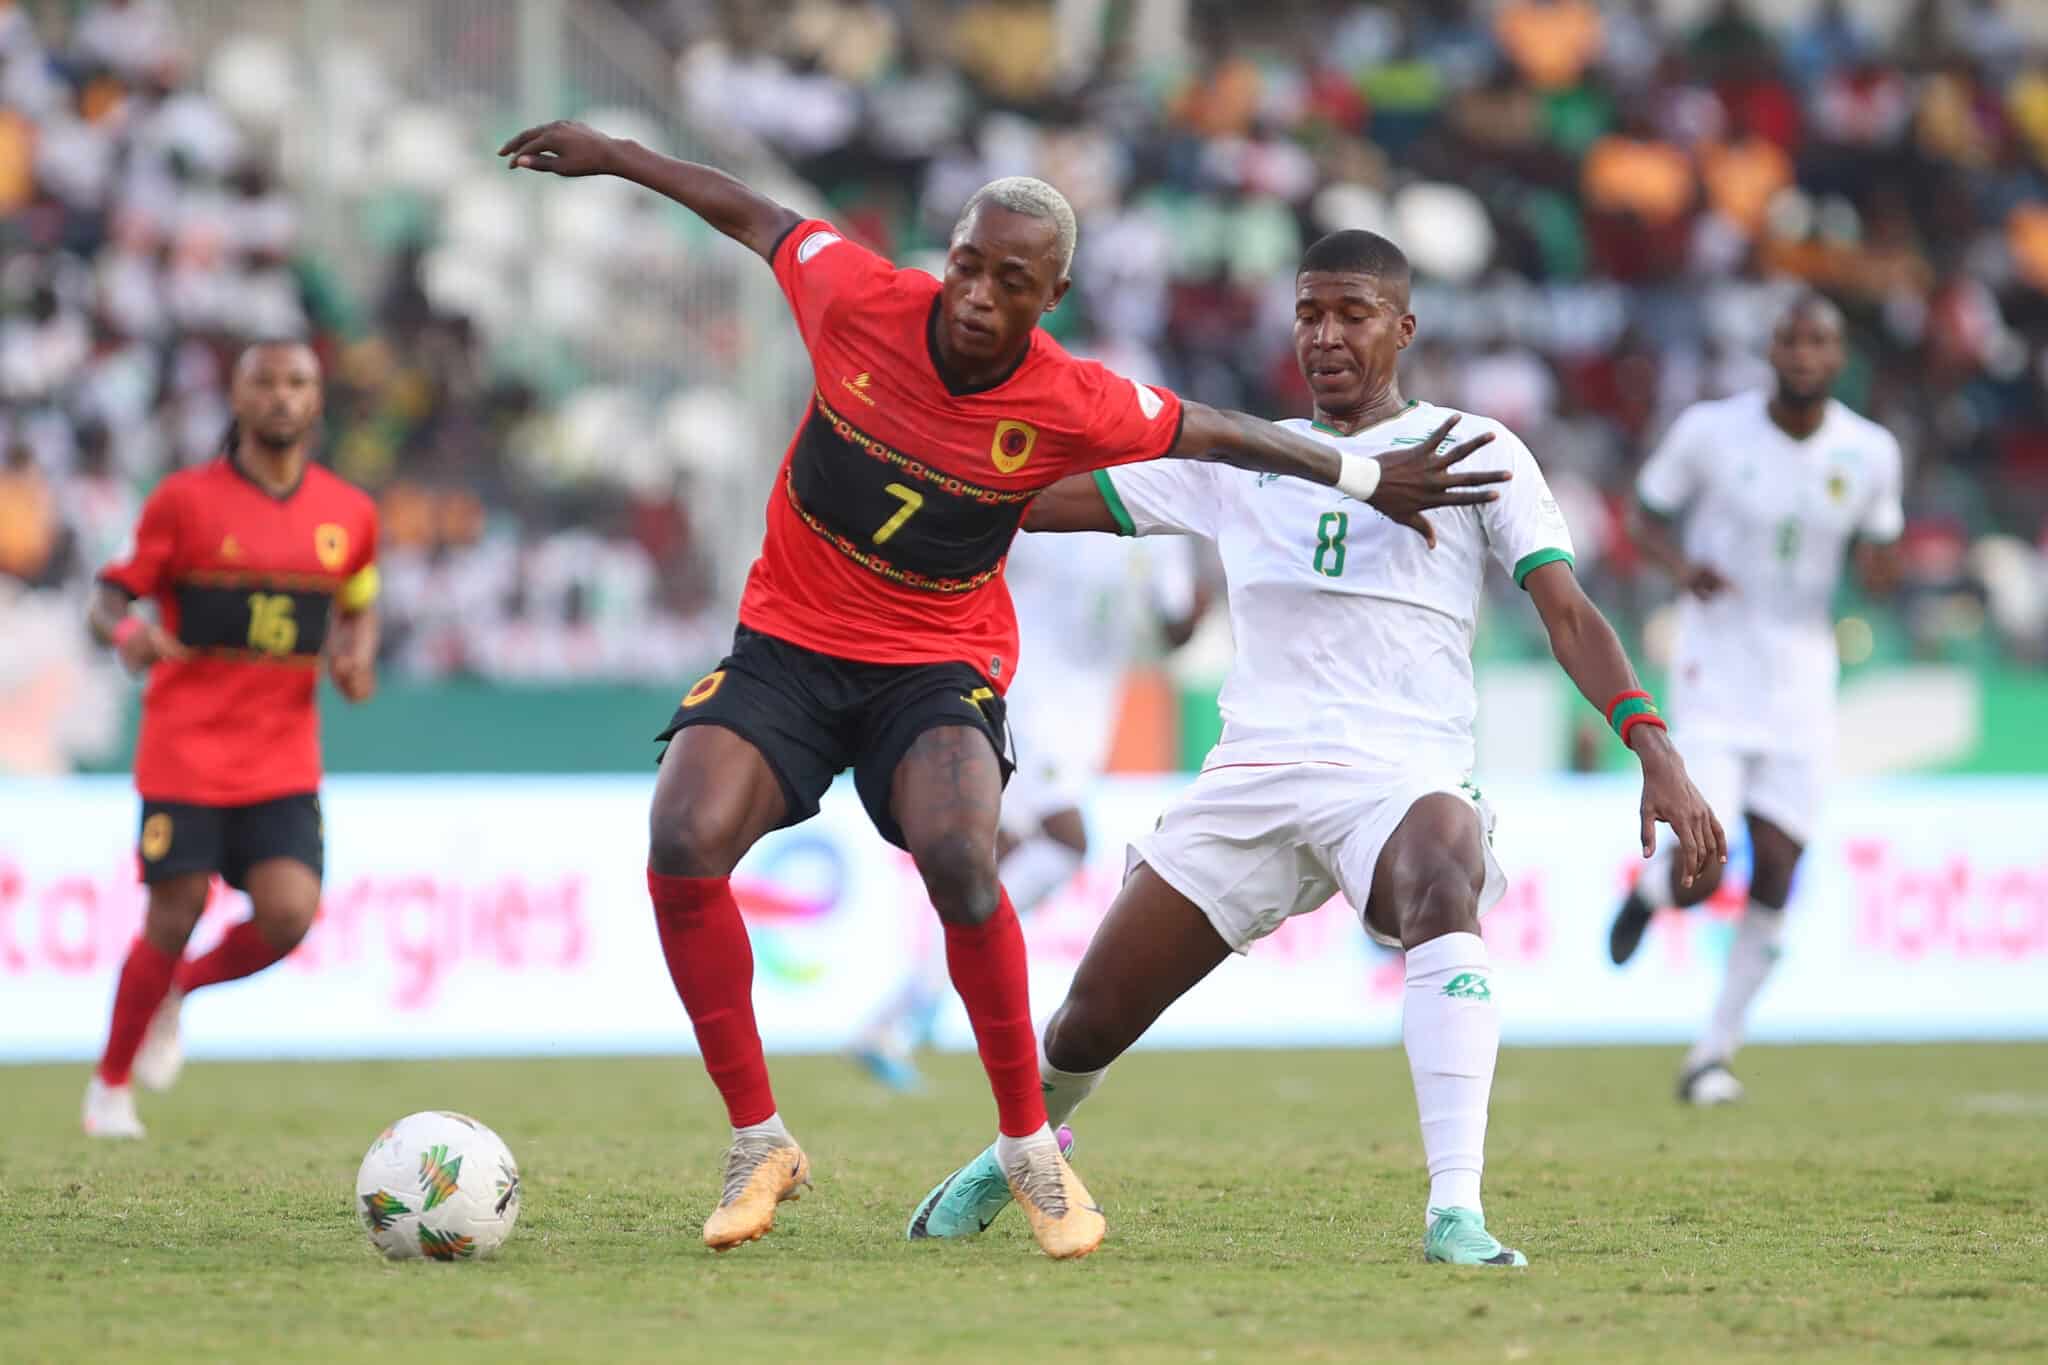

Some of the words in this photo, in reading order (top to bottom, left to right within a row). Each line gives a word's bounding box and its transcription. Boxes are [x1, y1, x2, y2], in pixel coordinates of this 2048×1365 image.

[871, 483, 924, 545] 7
[1313, 511, 1348, 577] 8
[246, 591, 299, 656] 16
